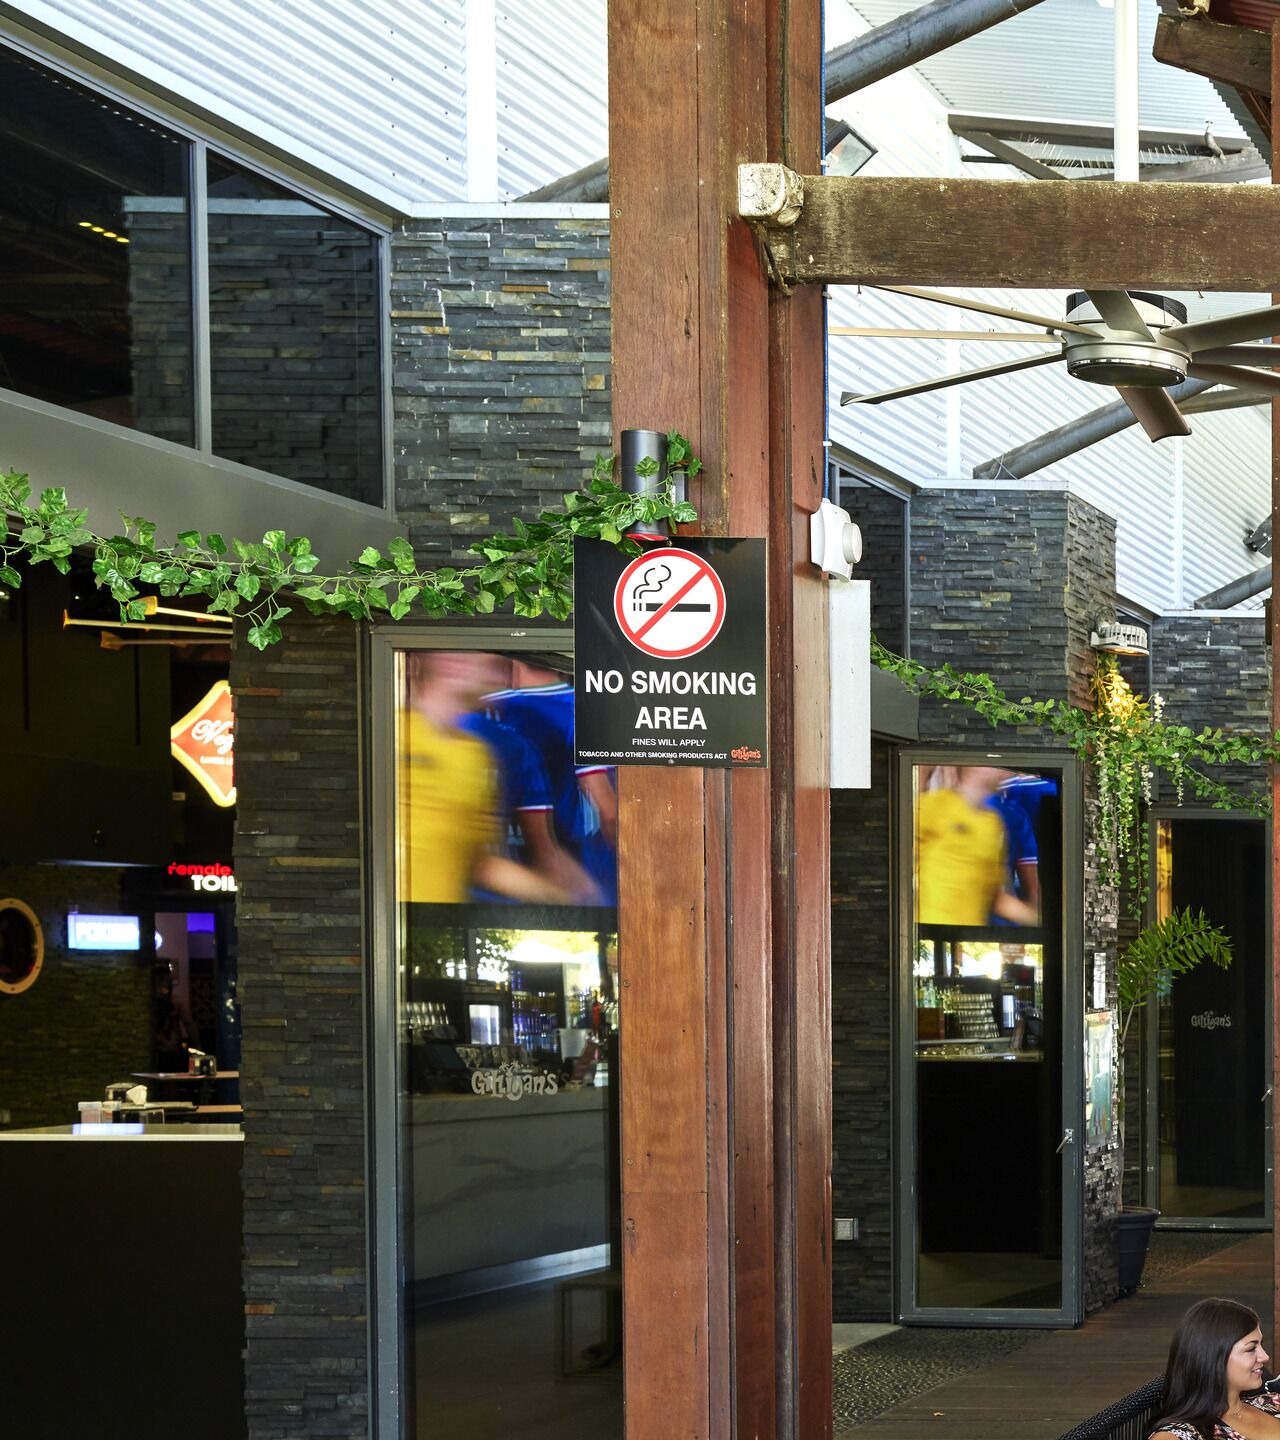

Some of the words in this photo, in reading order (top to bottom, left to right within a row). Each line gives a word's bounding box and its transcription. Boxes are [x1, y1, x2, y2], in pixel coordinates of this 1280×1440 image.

[585, 670, 624, 694] NO
[631, 670, 757, 696] SMOKING
[634, 706, 708, 730] AREA
[632, 738, 656, 746] FINES
[658, 738, 678, 746] WILL
[679, 739, 706, 747] APPLY
[191, 874, 239, 892] TOIL
